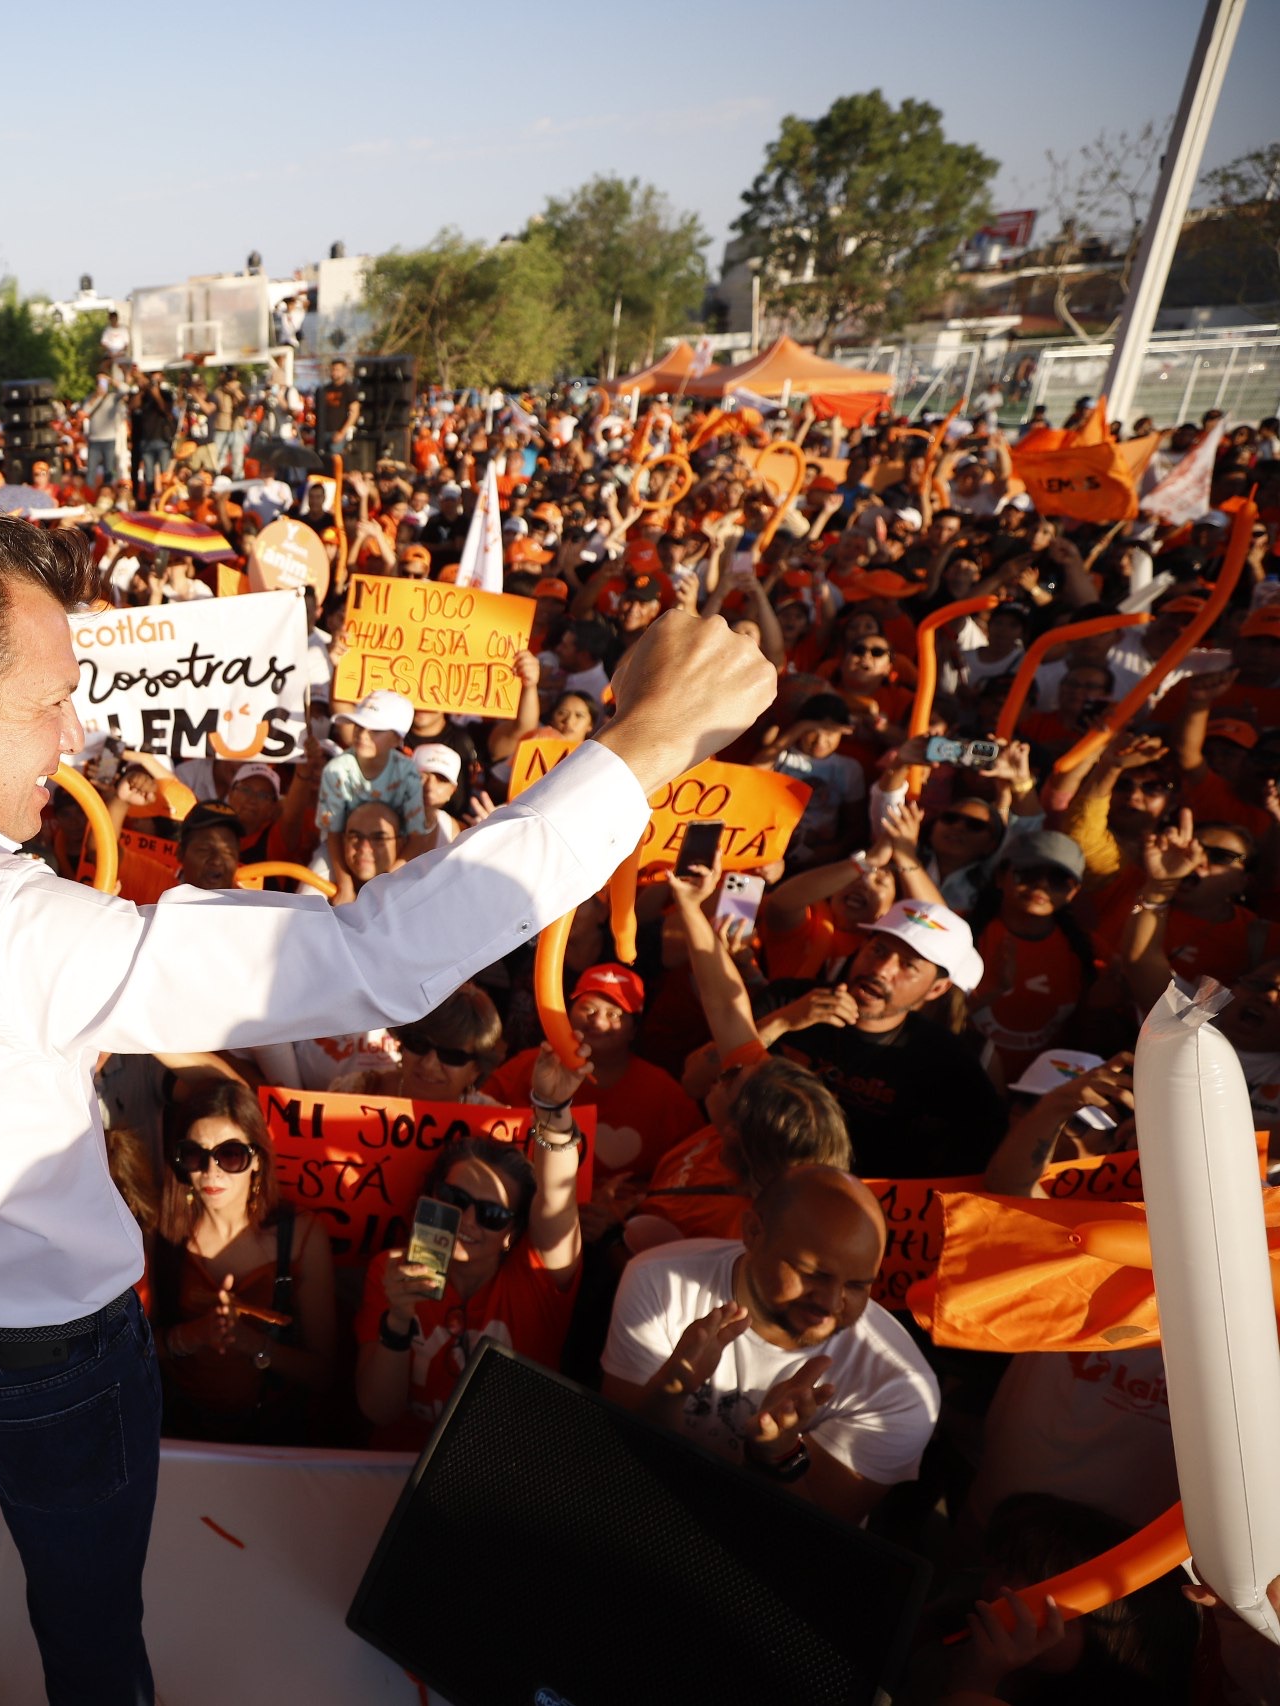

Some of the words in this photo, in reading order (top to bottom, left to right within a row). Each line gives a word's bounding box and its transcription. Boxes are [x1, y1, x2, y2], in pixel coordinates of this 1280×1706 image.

[354, 580, 392, 615] MI
[410, 587, 474, 622] JOCO
[72, 614, 175, 648] cotlán
[419, 624, 470, 656] ESTÁ
[647, 778, 731, 817] OCO
[138, 836, 157, 851] DE
[662, 821, 776, 857] ETÁ
[267, 1092, 324, 1139] MI
[1051, 1162, 1142, 1198] OCO
